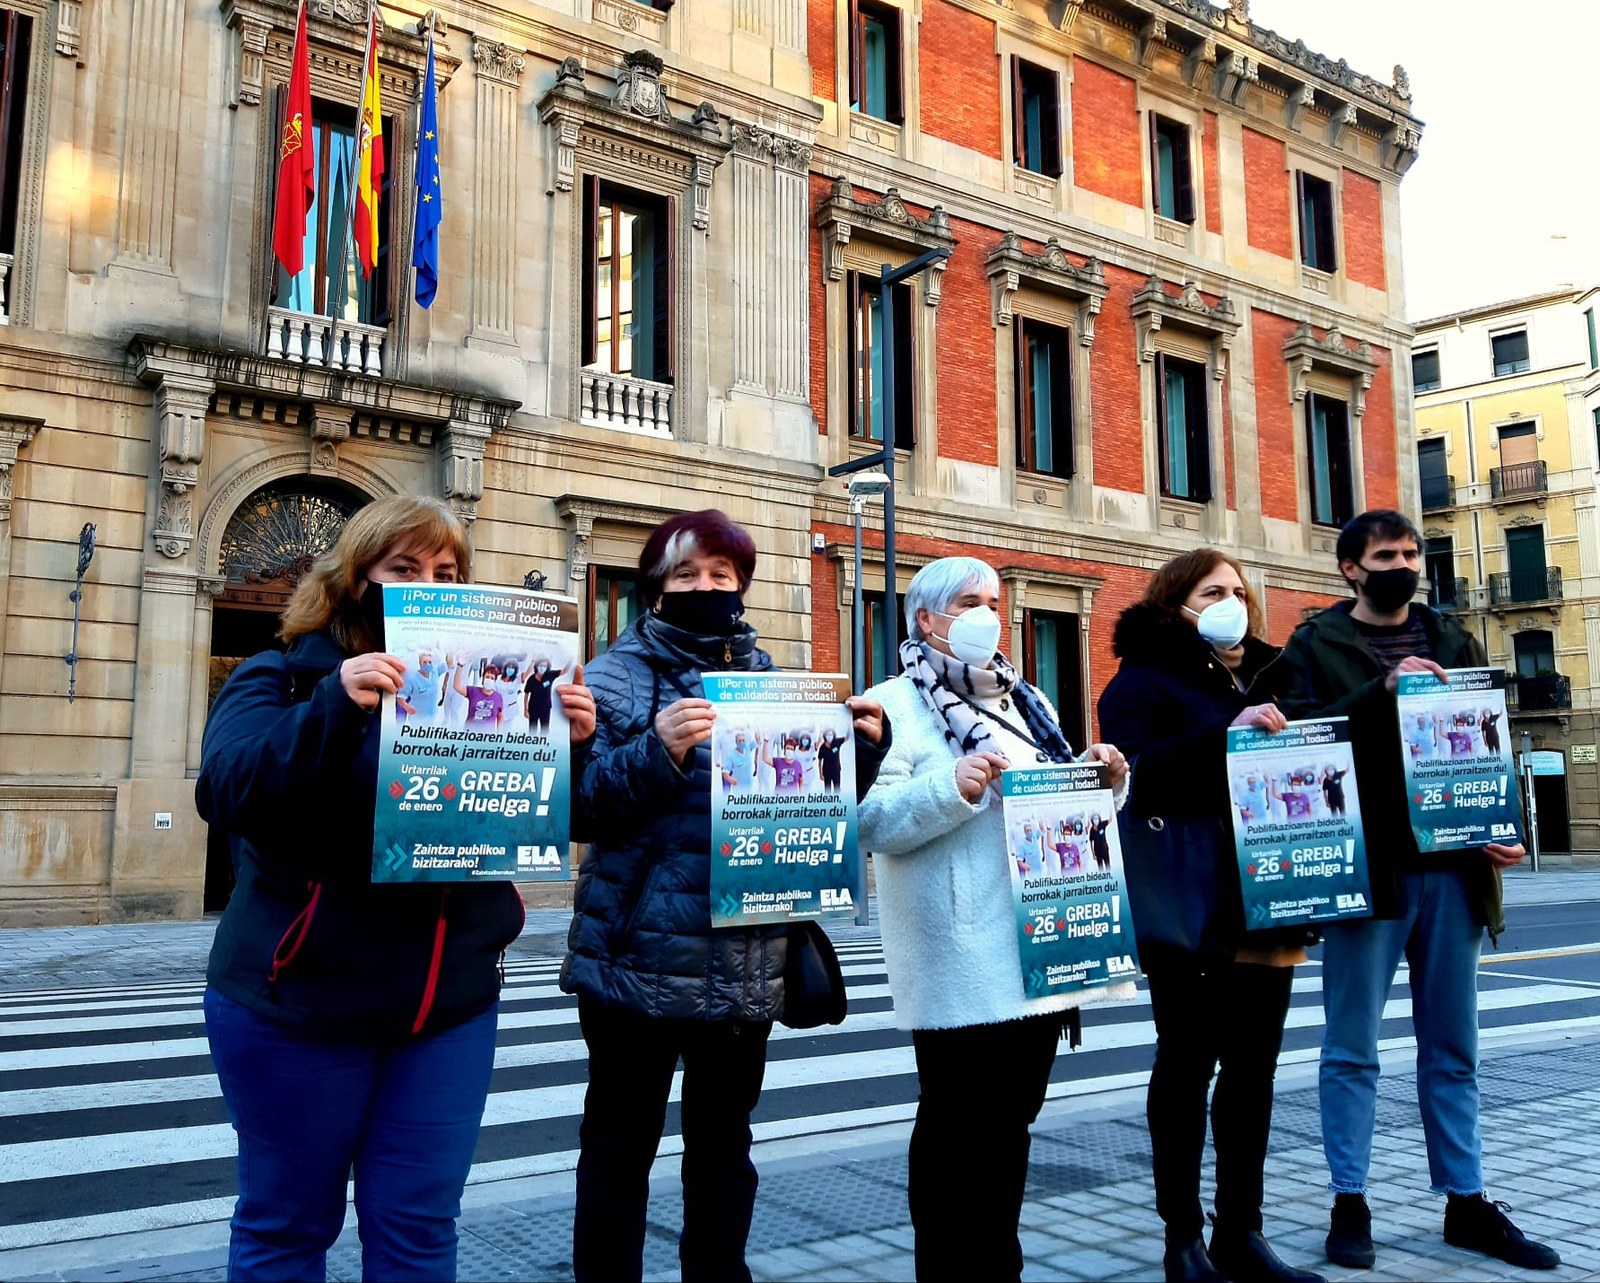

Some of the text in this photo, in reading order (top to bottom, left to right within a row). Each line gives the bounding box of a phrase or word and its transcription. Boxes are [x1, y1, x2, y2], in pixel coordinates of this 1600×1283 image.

[440, 592, 458, 602] un
[461, 592, 512, 607] sistema
[514, 598, 558, 614] público
[403, 604, 560, 628] de cuidados para todas!!
[745, 680, 758, 688] un
[760, 679, 797, 689] sistema
[800, 679, 833, 690] público
[720, 690, 837, 702] de cuidados para todas!!
[400, 725, 550, 746] Publifikazioaren bidean,
[1302, 725, 1332, 736] público
[1236, 733, 1336, 750] de cuidados para todas!!
[392, 741, 556, 762] borrokak jarraitzen du!
[401, 764, 448, 776] Urtarrilak
[1042, 771, 1070, 780] sistema
[1071, 769, 1097, 780] público
[404, 776, 440, 800] 26
[460, 770, 536, 792] GREBA
[1012, 779, 1100, 793] de cuidados para todas!!
[399, 802, 443, 812] de enero
[458, 793, 530, 817] Huelga
[727, 793, 842, 805] Publifikazioaren bidean,
[722, 806, 847, 821] borrokak jarraitzen du!
[728, 827, 765, 836] Urtarrilak
[1247, 818, 1348, 834] Publifikazioaren bidean,
[774, 827, 833, 846] GREBA
[1244, 826, 1354, 846] borrokak jarraitzen du!
[412, 844, 506, 858] Zaintza publikoa
[732, 836, 759, 857] 26
[1292, 845, 1343, 863] GREBA
[412, 857, 479, 869] bizitzarako!
[518, 846, 561, 865] ELA
[728, 858, 762, 866] de enero
[774, 846, 828, 866] Huelga
[1257, 856, 1280, 874] 26
[1294, 862, 1341, 878] Huelga
[1024, 872, 1113, 889] Publifikazioaren bidean,
[742, 890, 812, 902] Zaintza publikoa
[820, 888, 853, 906] ELA
[1022, 881, 1118, 903] borrokak jarraitzen du!
[742, 902, 793, 914] bizitzarako!
[1270, 897, 1330, 910] Zaintza publikoa
[1336, 893, 1366, 908] ELA
[1028, 906, 1058, 916] Urtarrilak
[1066, 902, 1110, 922] GREBA
[1271, 906, 1313, 918] bizitzarako!
[1034, 915, 1055, 936] 26
[1068, 920, 1108, 938] Huelga
[1032, 934, 1059, 944] de enero
[1046, 960, 1100, 976] Zaintza publikoa
[1106, 955, 1136, 972] ELA
[1048, 971, 1086, 986] bizitzarako!
